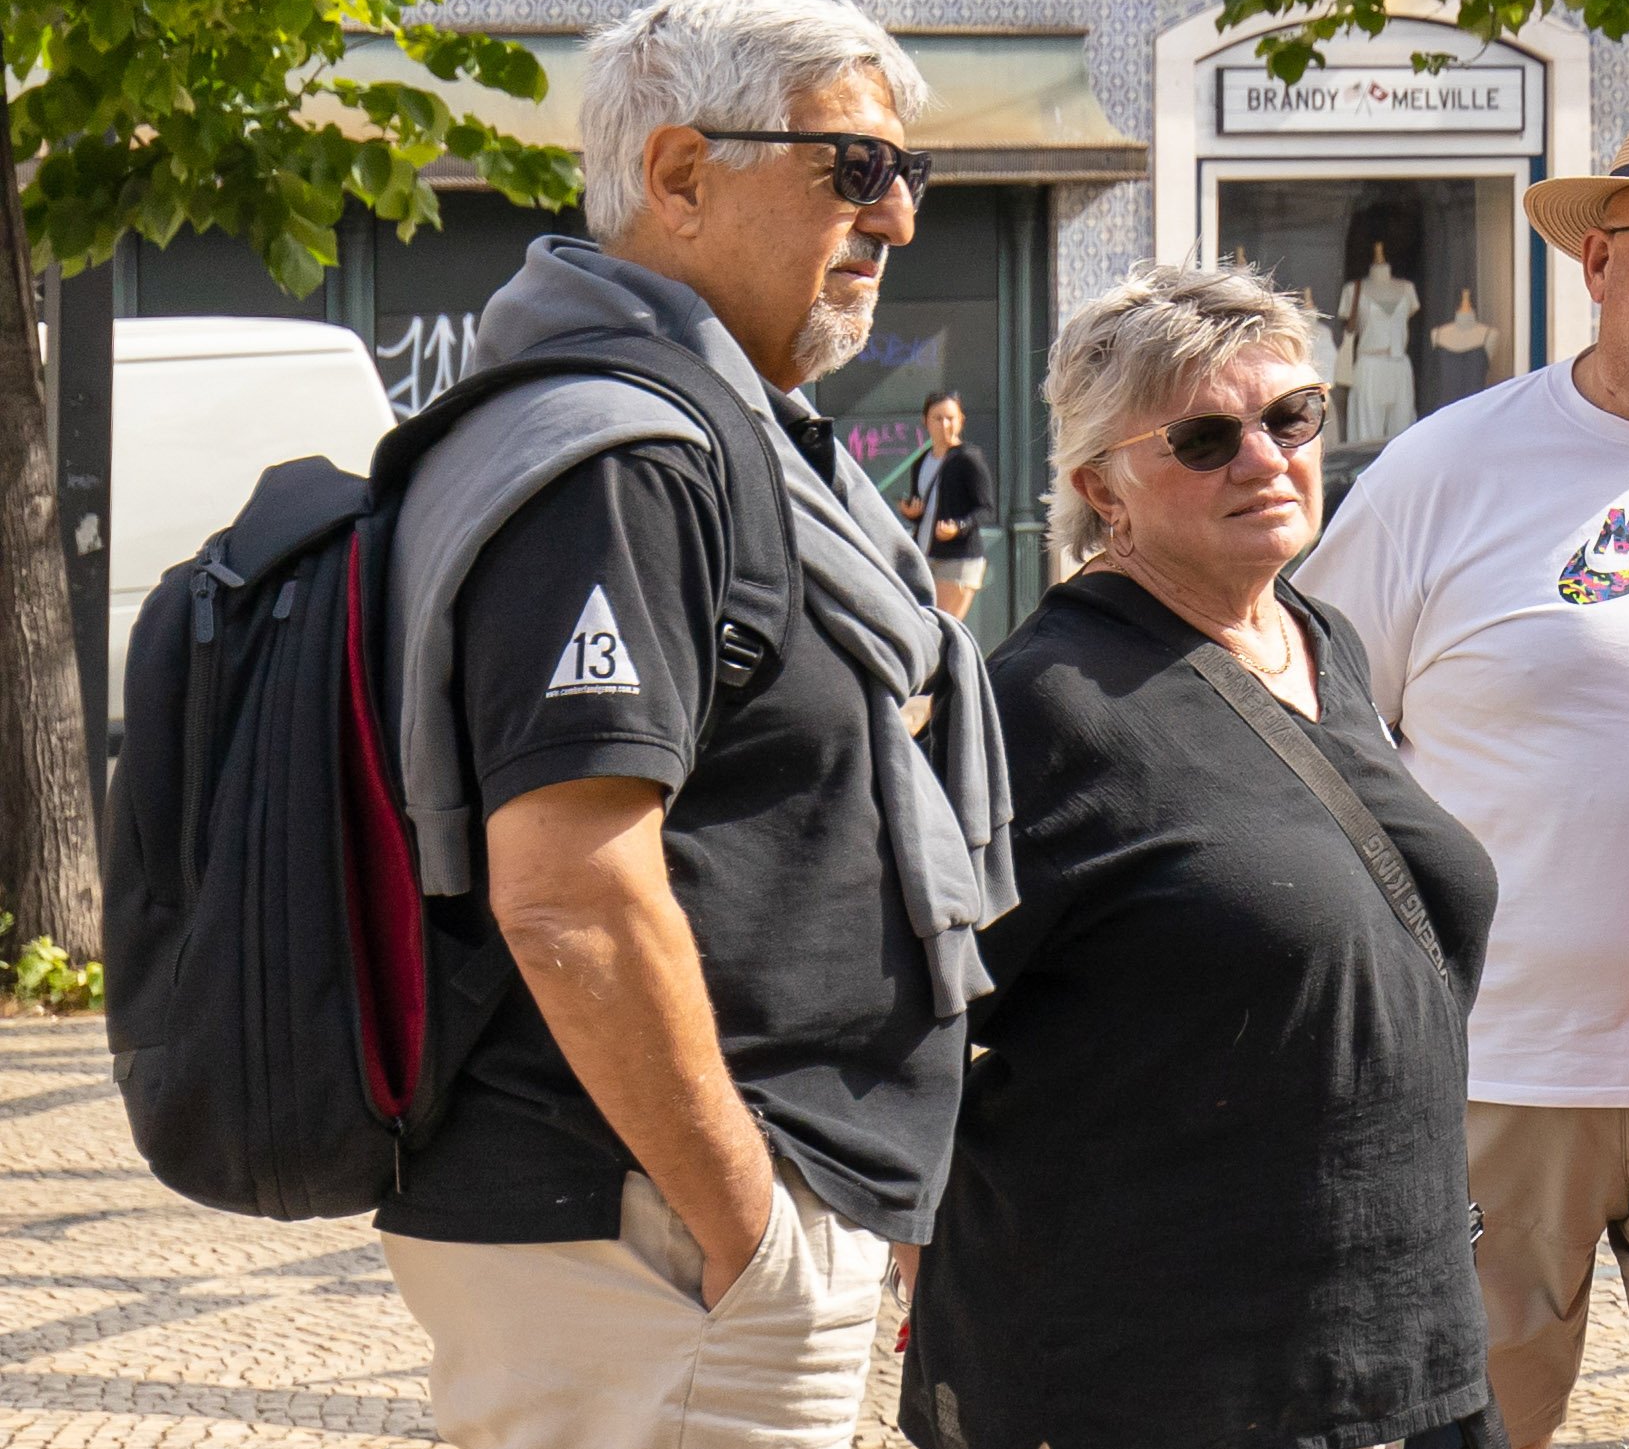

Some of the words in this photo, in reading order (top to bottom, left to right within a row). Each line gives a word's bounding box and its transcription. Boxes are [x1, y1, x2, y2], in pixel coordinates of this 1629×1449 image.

[1246, 87, 1340, 112] BRANDY
[1391, 87, 1501, 111] MELVILLE
[573, 632, 617, 680] 13
[1361, 833, 1412, 900] KING
